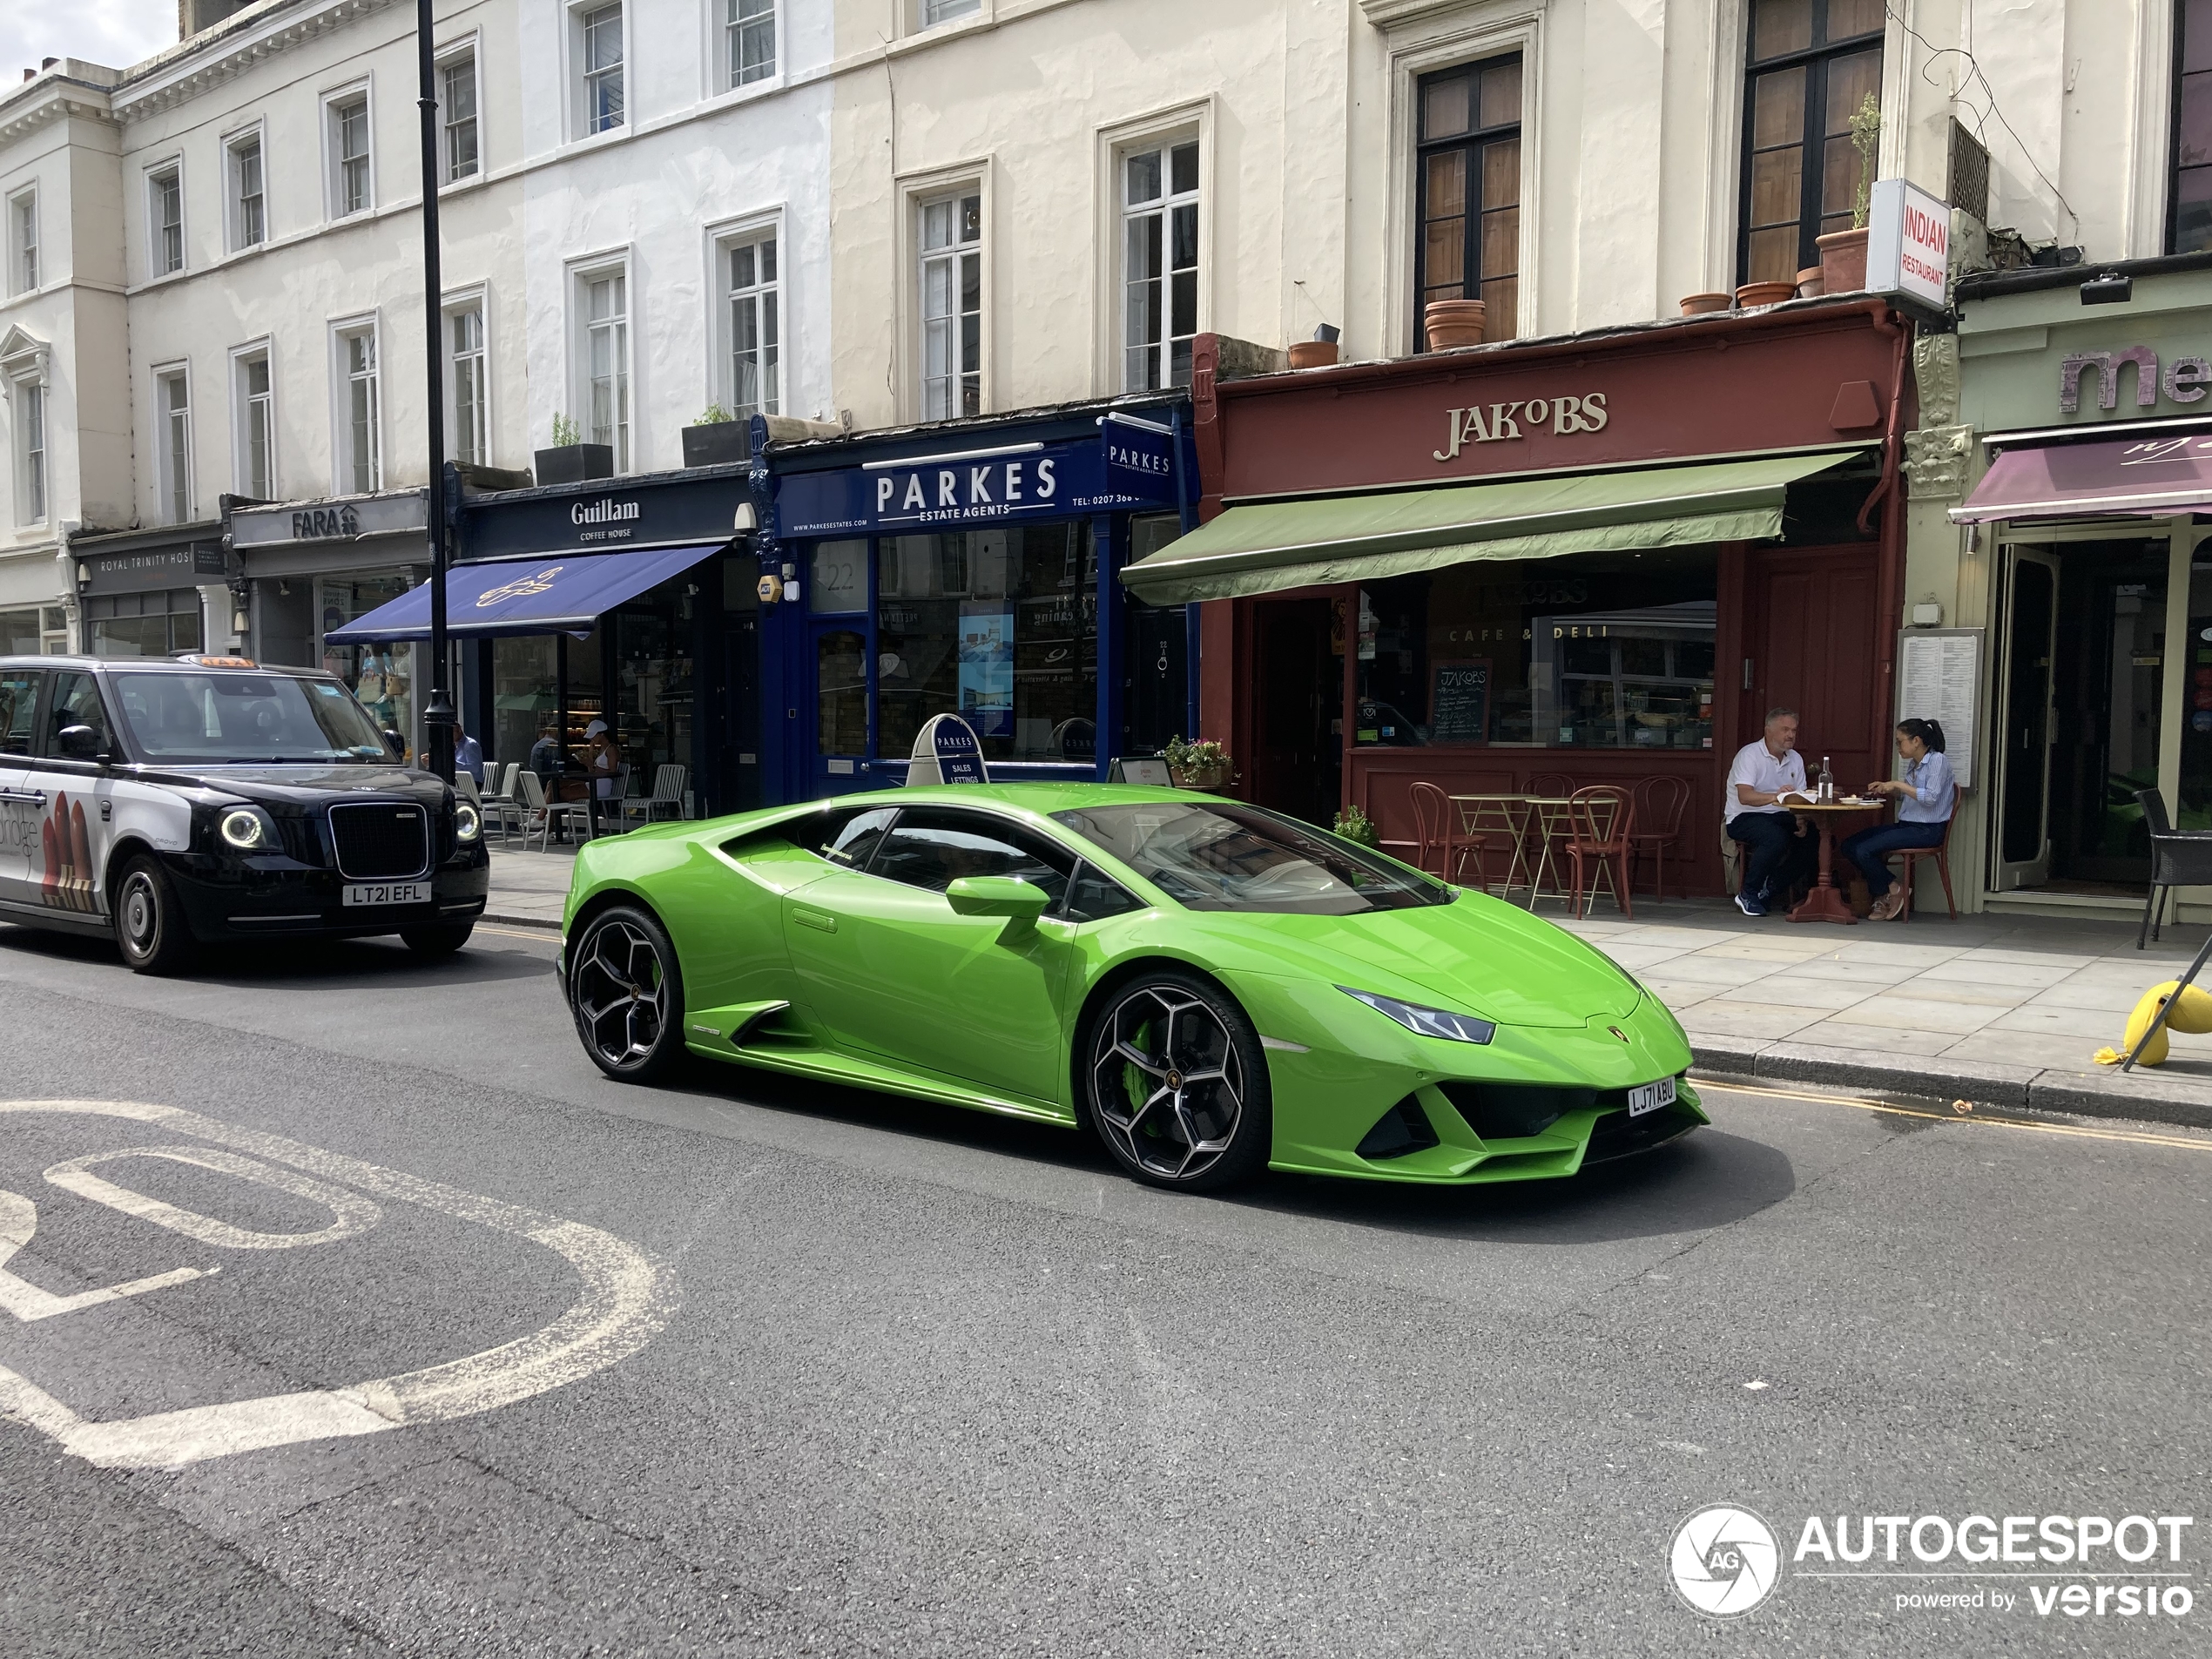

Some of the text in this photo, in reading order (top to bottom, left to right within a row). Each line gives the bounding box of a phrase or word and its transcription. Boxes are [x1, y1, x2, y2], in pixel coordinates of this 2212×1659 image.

[1905, 205, 1946, 255] INDIAN
[1902, 253, 1944, 287] RESTAURANT
[1109, 445, 1170, 473] PARKES
[1125, 463, 1140, 472] ESTATE
[876, 459, 1056, 513] PARKES
[1072, 497, 1090, 507] TEL:
[1092, 495, 1114, 505] 0207
[570, 498, 641, 525] Guillam
[920, 504, 1010, 522] ESTATE AGENTS
[292, 509, 341, 538] FARA
[792, 520, 867, 531] WWW.PARKESESTATES.COM
[580, 528, 632, 541] COFFEE HOUSE
[101, 561, 128, 572] ROYAL
[132, 555, 165, 569] TRINITY
[827, 563, 853, 590] 22
[1449, 625, 1607, 642] CAFE & DELI
[1159, 640, 1168, 649] 22
[204, 658, 253, 667] TAXI
[1440, 671, 1486, 686] JAKOBS
[937, 737, 972, 746] PARKES
[952, 764, 972, 772] SALES
[950, 775, 979, 785] LETTINGS
[353, 885, 422, 903] LT21 EFL
[1632, 1079, 1673, 1112] LJ71 ABU
